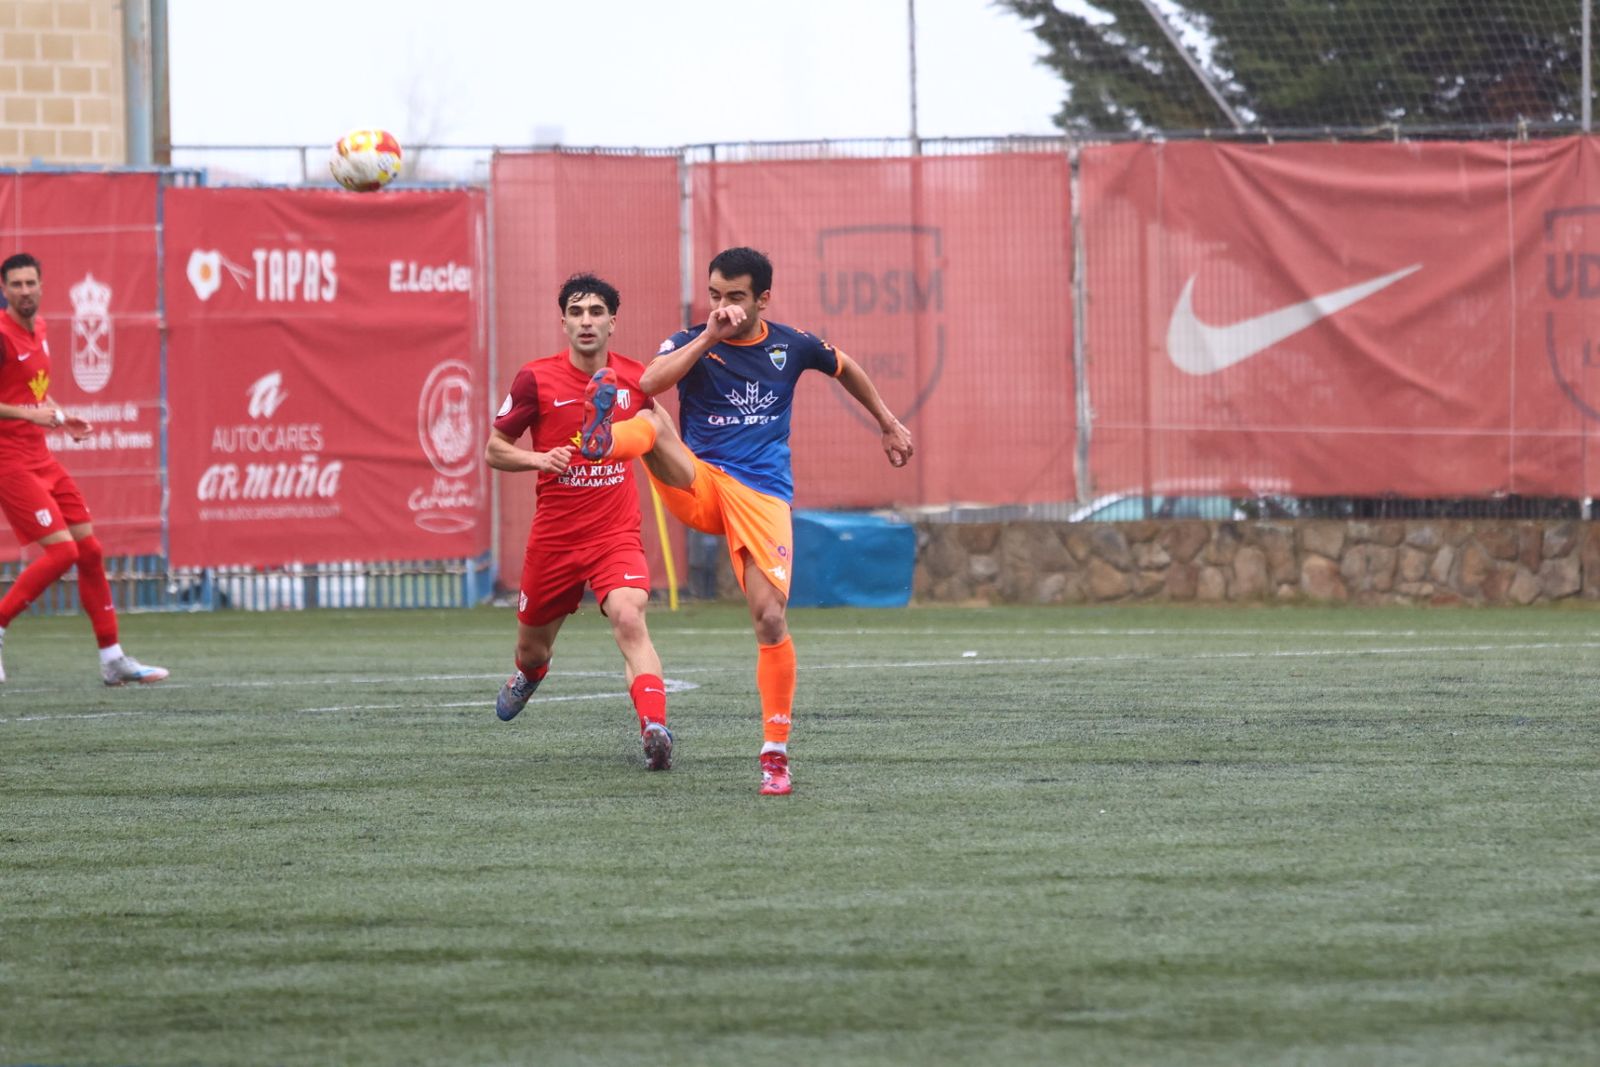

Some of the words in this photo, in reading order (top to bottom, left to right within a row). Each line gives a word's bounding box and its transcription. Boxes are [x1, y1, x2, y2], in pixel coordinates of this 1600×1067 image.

[252, 249, 337, 302] TAPAS
[389, 260, 471, 292] E.Lecle
[819, 269, 944, 315] UDSM
[211, 423, 324, 453] AUTOCARES
[565, 465, 587, 478] AJA
[590, 462, 625, 477] RURAL
